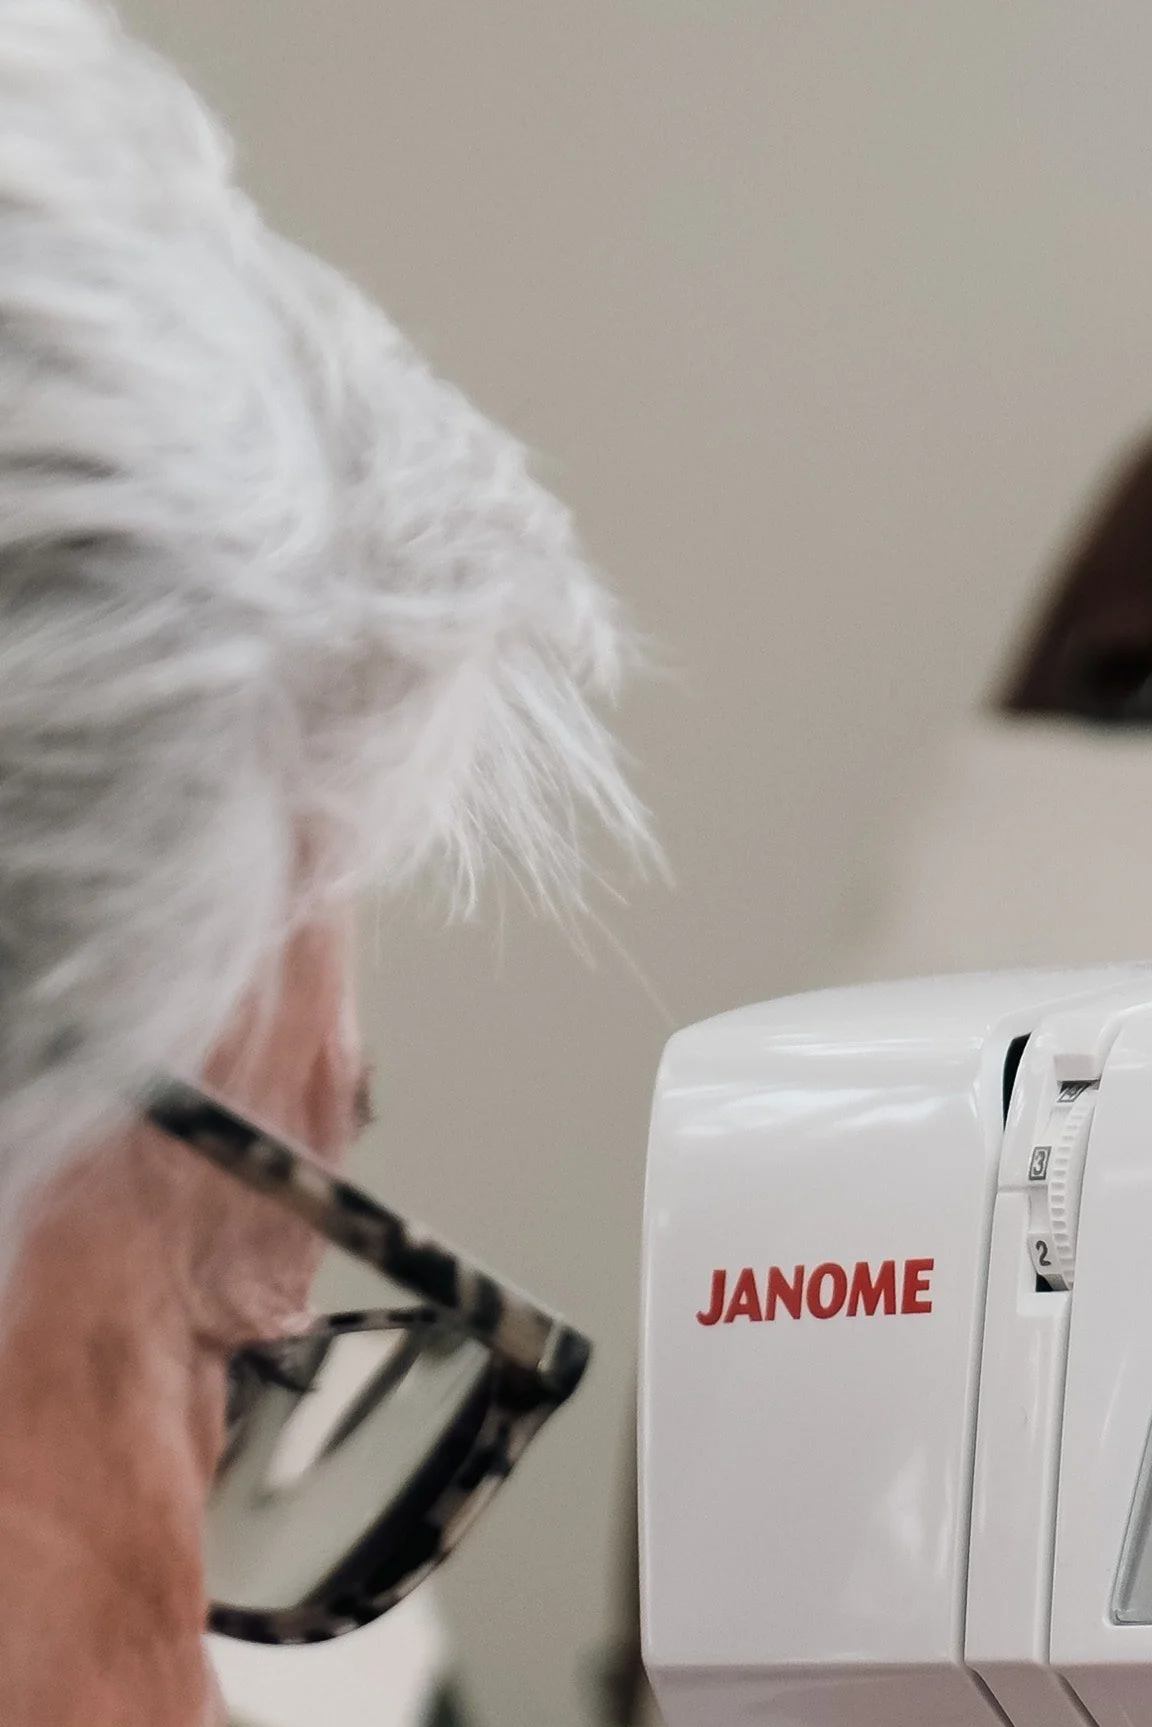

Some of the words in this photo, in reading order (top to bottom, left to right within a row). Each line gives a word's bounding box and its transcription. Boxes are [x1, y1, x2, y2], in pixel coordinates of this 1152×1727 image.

[1033, 1150, 1046, 1176] 3
[1035, 1240, 1052, 1266] 2
[695, 1258, 935, 1326] JANOME
